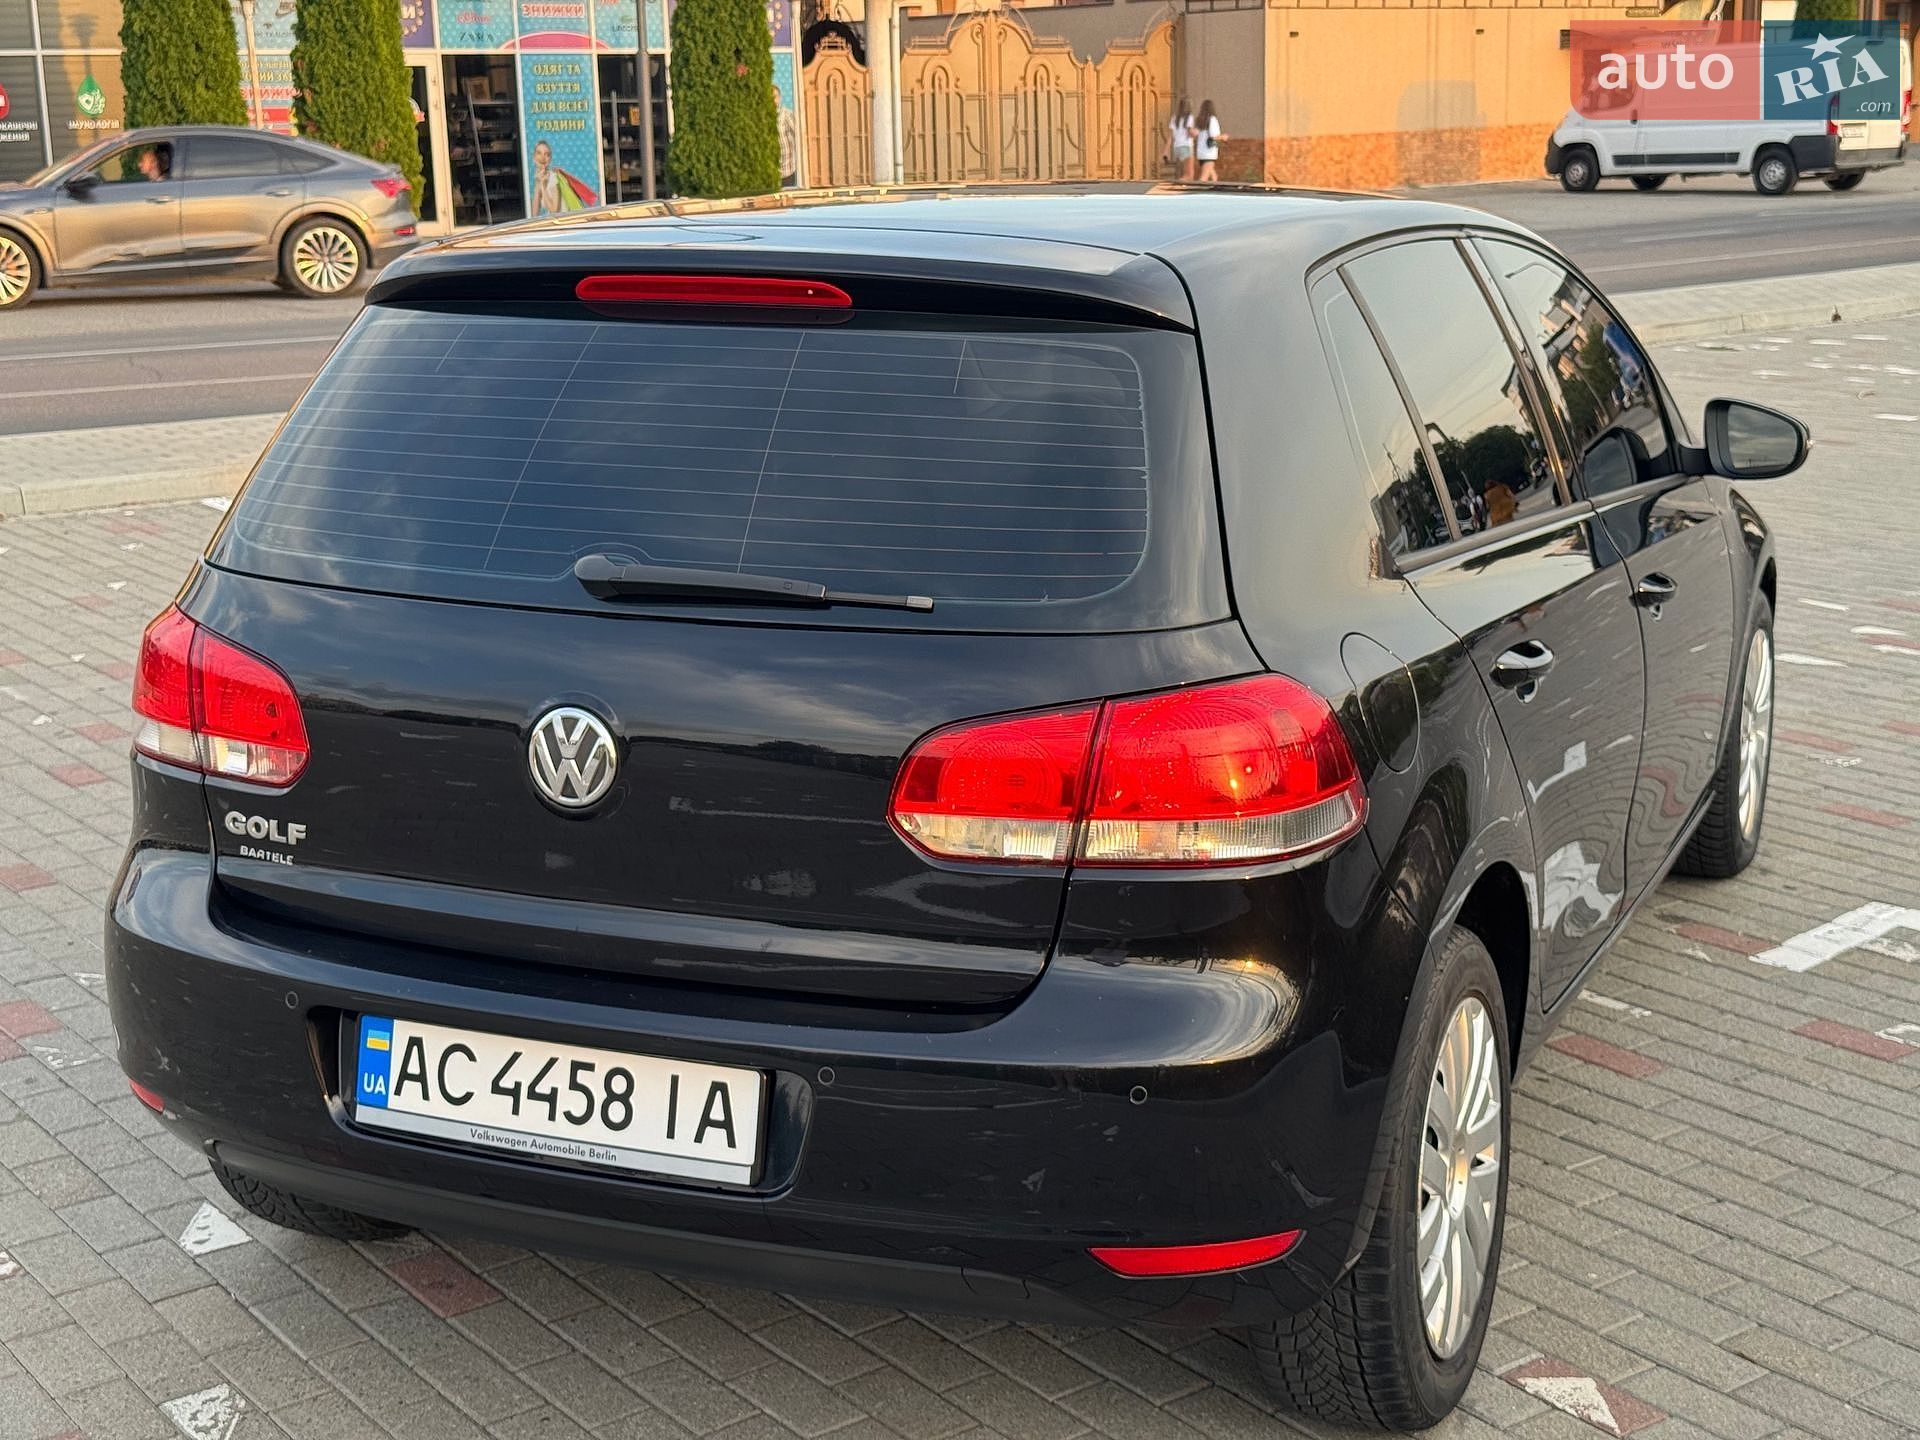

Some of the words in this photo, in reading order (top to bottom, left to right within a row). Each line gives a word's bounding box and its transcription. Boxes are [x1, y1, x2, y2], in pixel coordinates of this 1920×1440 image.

[521, 4, 585, 17] ЗНИЖКИ
[533, 64, 562, 76] ОДЯГ
[567, 64, 581, 75] ТА
[535, 83, 580, 94] ВЗУТТЯ
[531, 101, 556, 114] ДЛЯ
[535, 119, 585, 132] РОДИНИ
[224, 810, 307, 846] GOLF
[363, 1071, 387, 1096] UA
[393, 1035, 477, 1106] AC
[490, 1051, 636, 1132] 4458
[666, 1074, 737, 1149] IA
[470, 1127, 527, 1148] Volkswagen
[530, 1138, 586, 1157] Automobile
[589, 1147, 617, 1162] Berlin
